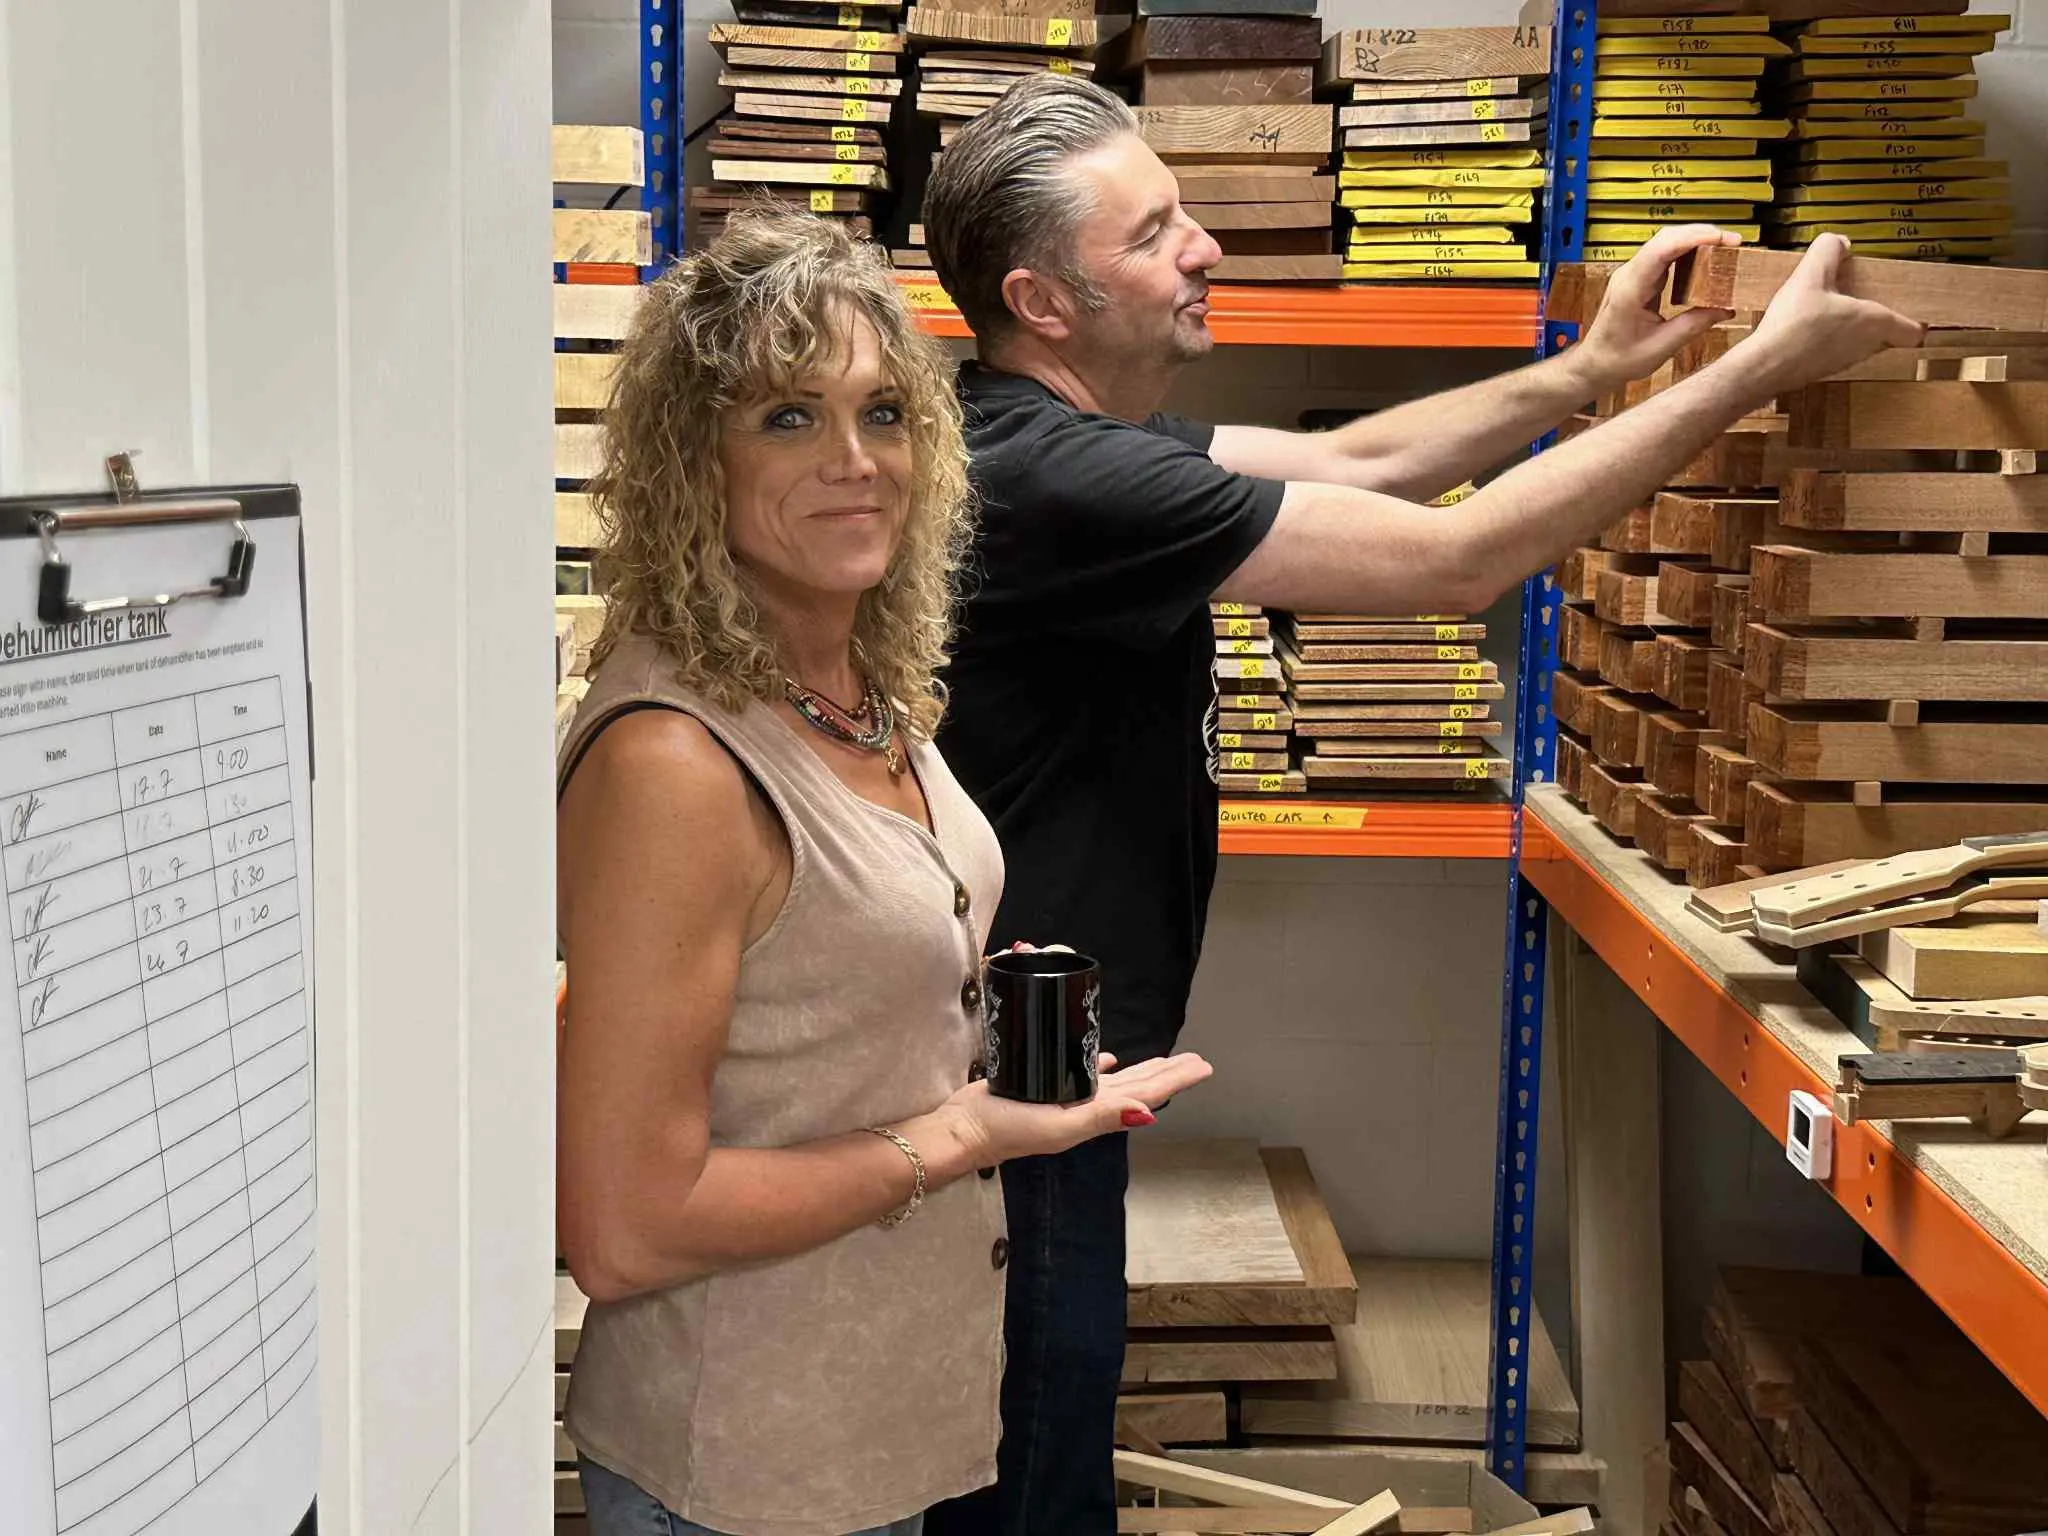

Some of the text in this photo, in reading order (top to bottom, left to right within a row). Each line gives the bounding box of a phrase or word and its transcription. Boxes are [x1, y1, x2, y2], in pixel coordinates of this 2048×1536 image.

[0, 607, 168, 659] ehumidifier tank
[1220, 810, 1266, 822] QUILTED
